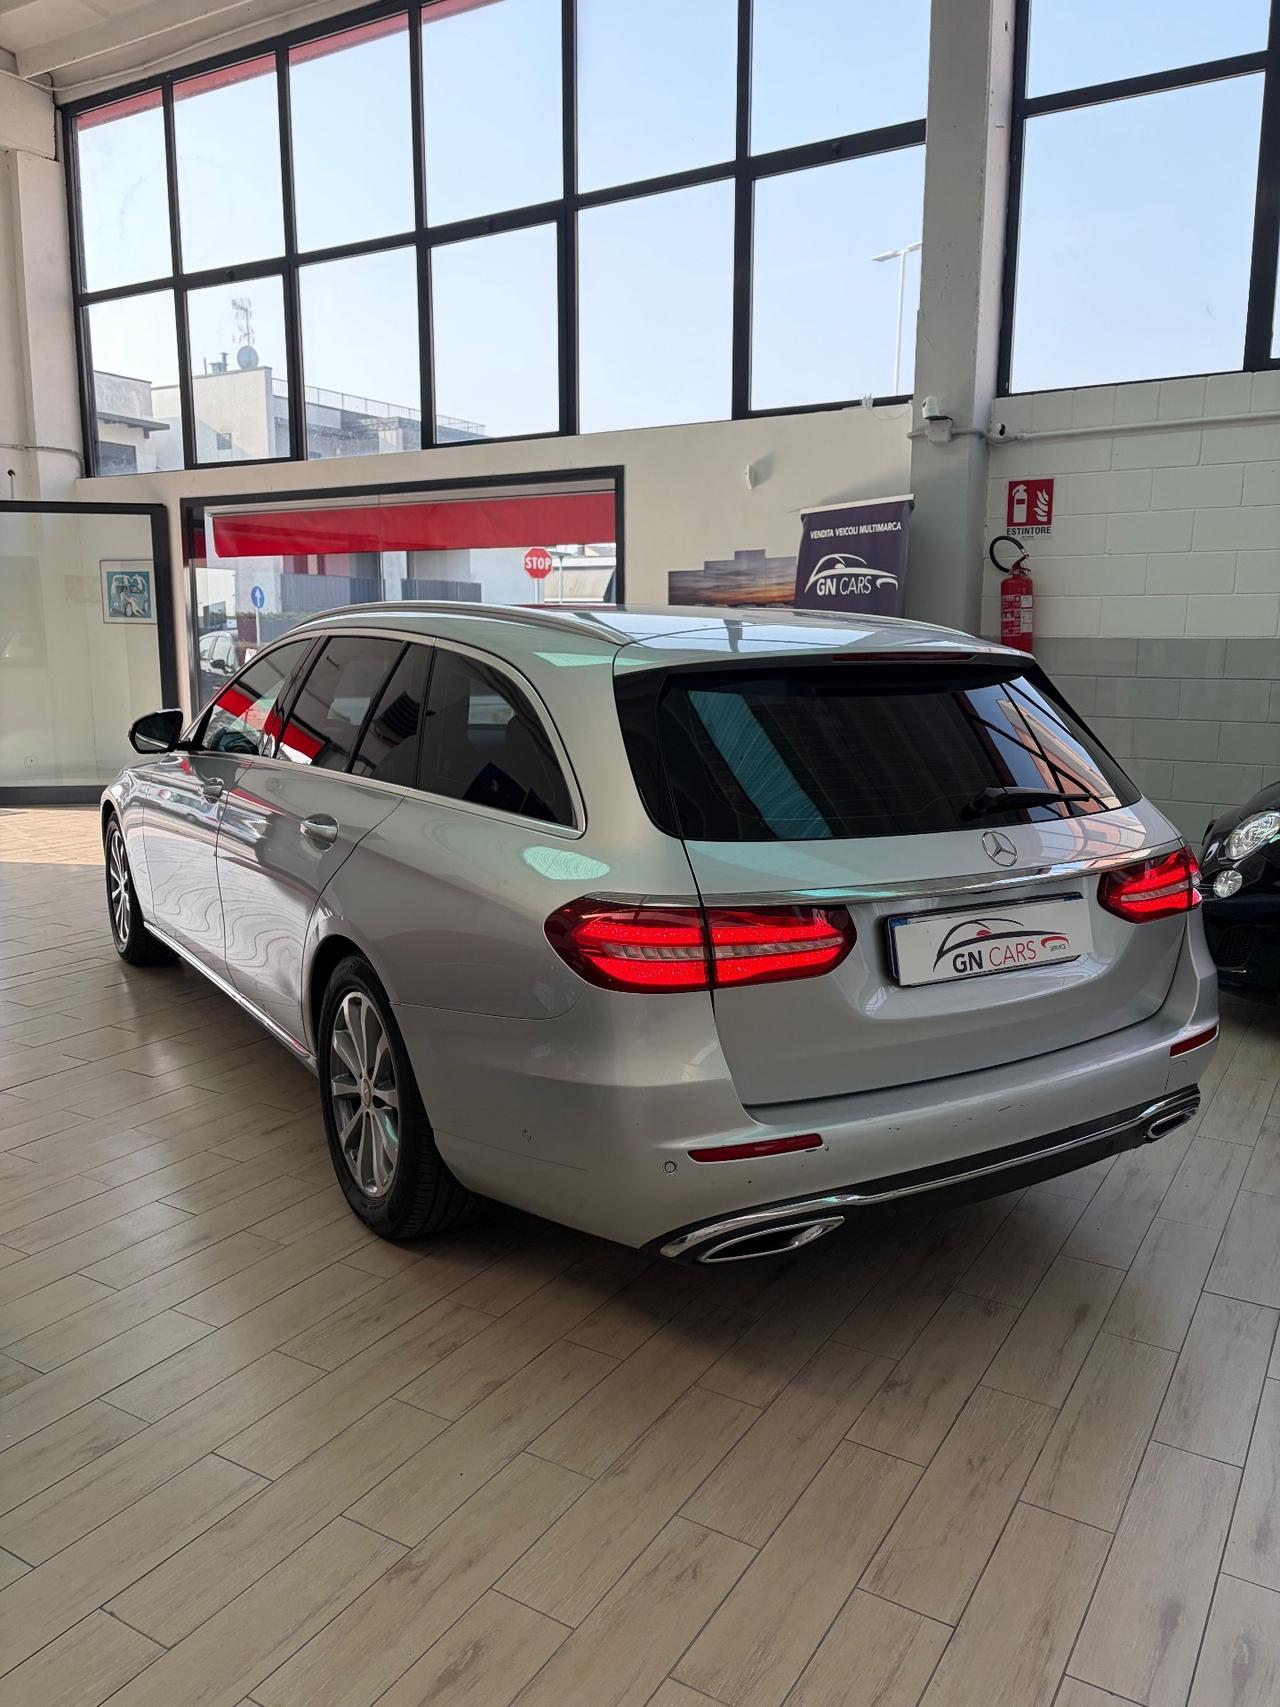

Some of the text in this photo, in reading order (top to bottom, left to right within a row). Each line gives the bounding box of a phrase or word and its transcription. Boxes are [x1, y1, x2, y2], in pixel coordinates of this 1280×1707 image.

[810, 521, 902, 539] VENDITA VEICOLI MULTIMARCA
[1006, 526, 1052, 536] ESTINTORE
[525, 557, 552, 570] STOP
[816, 576, 872, 596] GN CARS
[952, 940, 1037, 974] GN CARS
